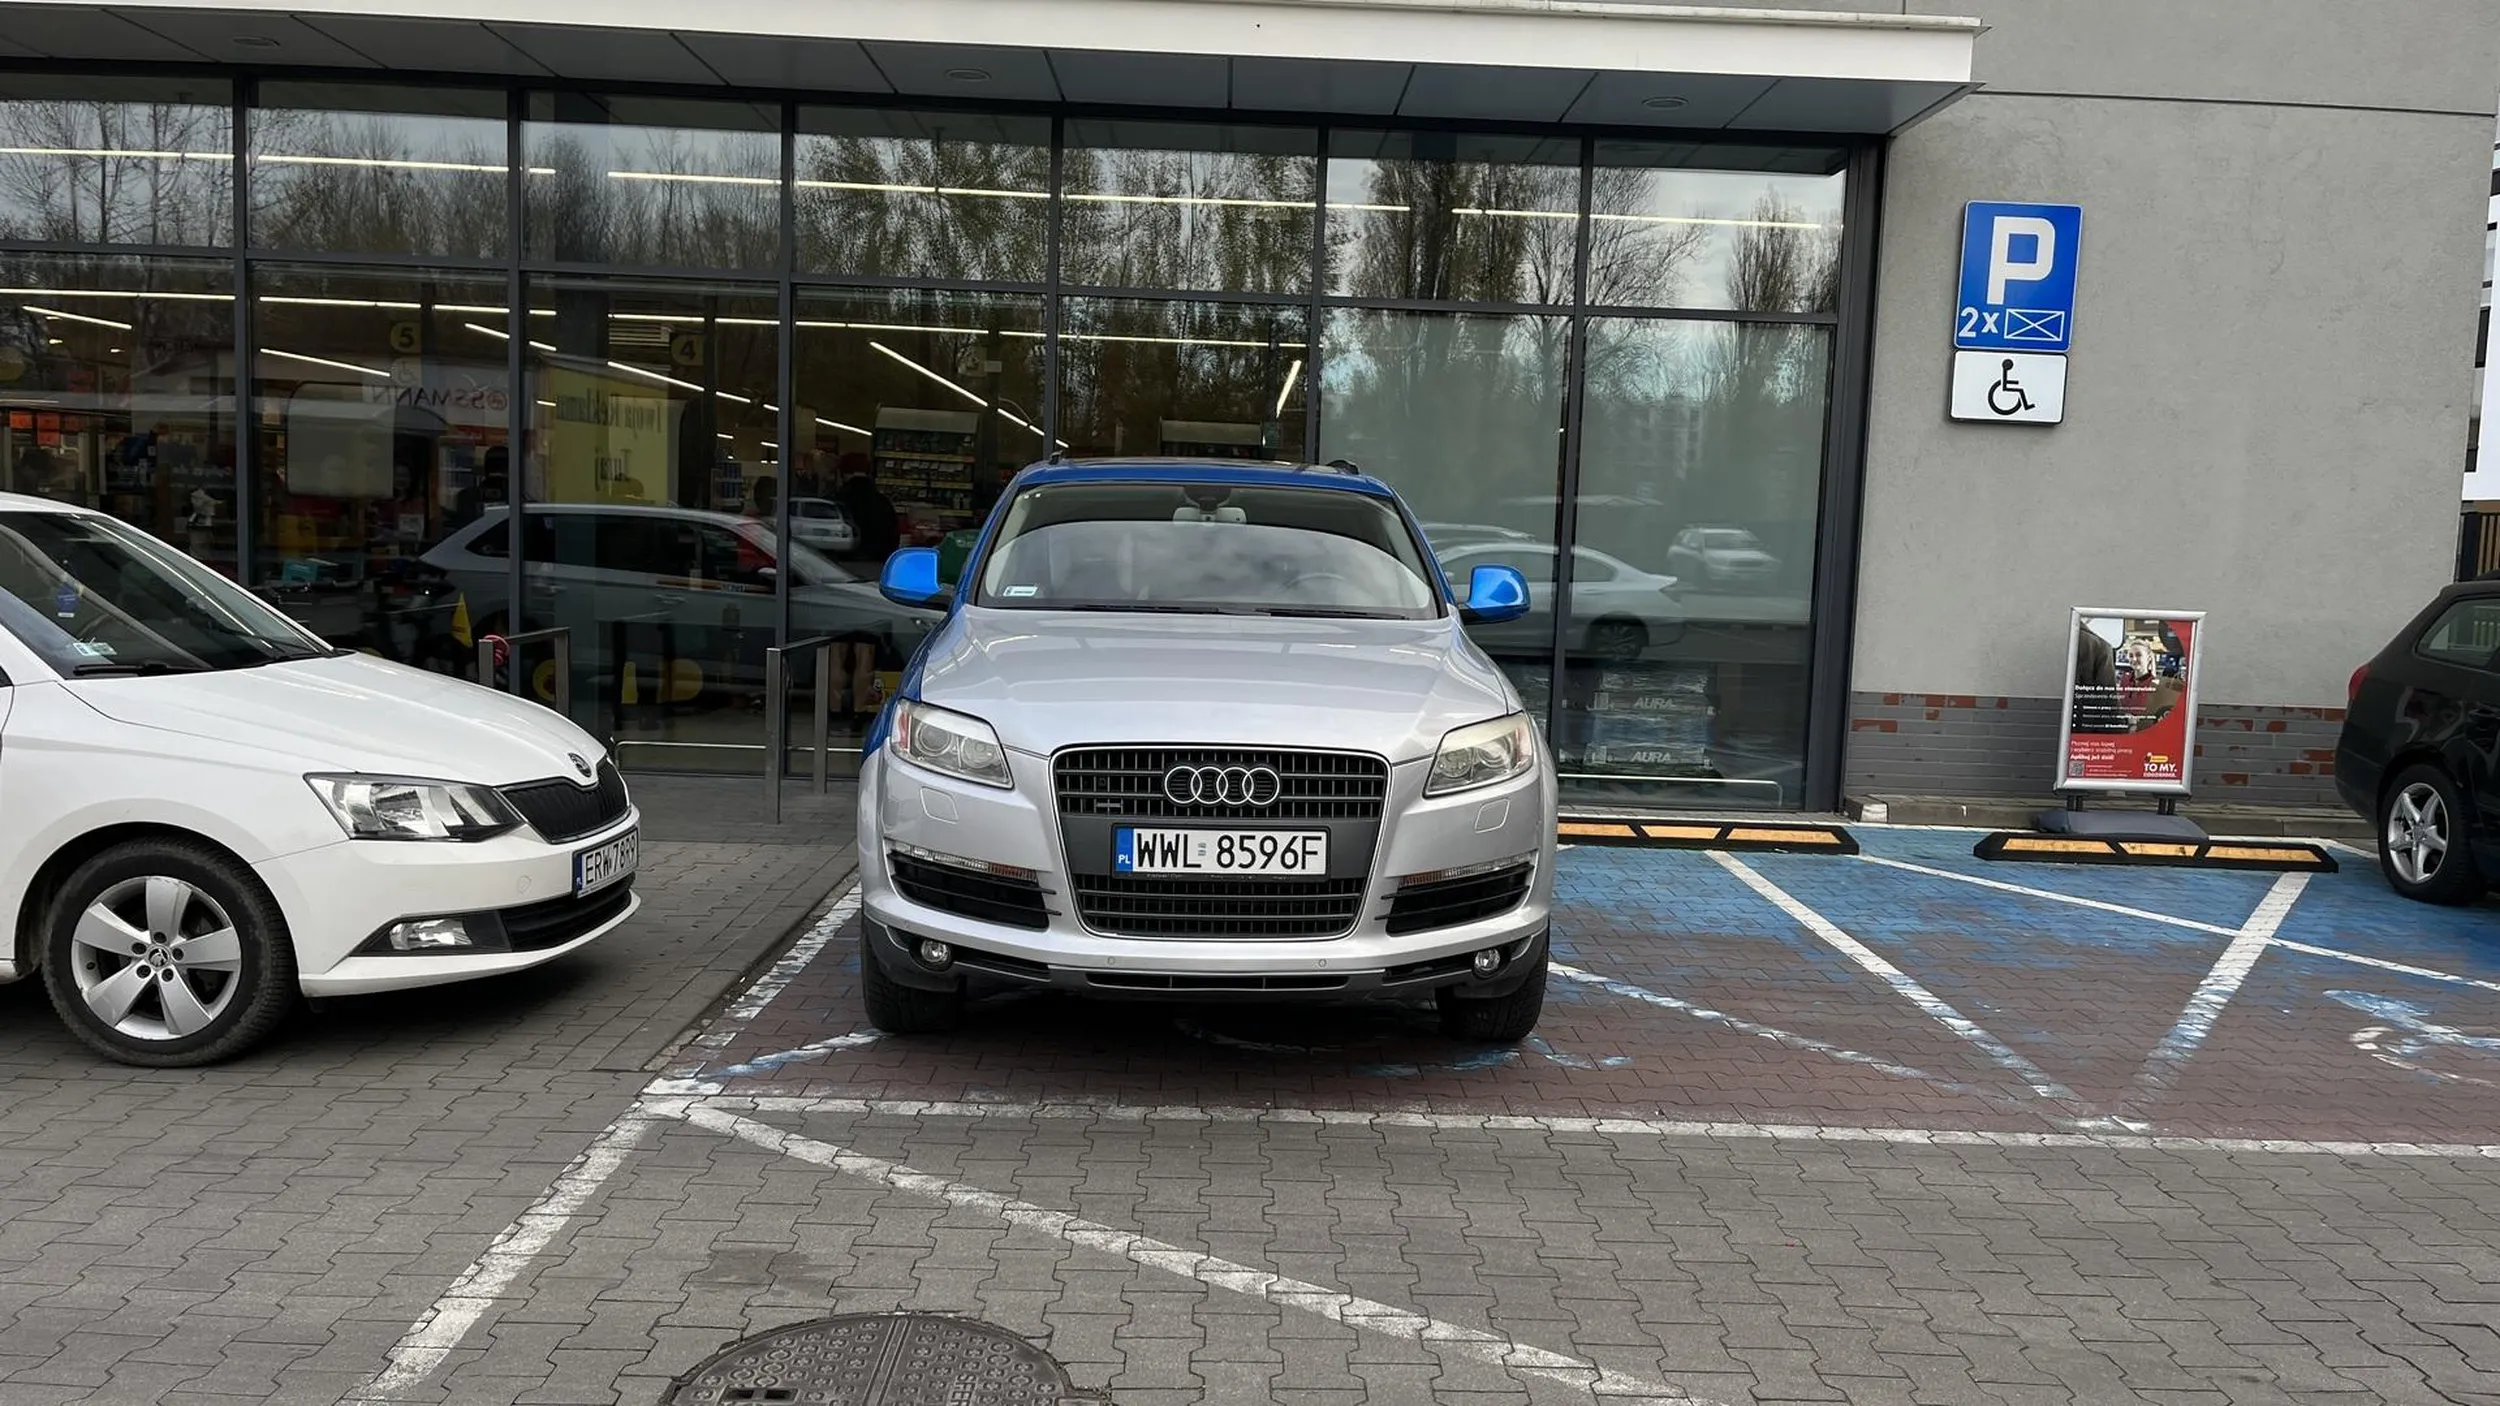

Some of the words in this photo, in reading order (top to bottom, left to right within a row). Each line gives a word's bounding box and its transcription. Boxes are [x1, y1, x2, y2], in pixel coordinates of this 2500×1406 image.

[1987, 216, 2055, 305] P
[399, 327, 414, 348] 5
[680, 340, 696, 360] 4
[1633, 697, 1675, 709] AURA
[1631, 751, 1672, 762] AURA
[2144, 763, 2158, 772] TO
[2159, 763, 2178, 773] MY.
[1118, 854, 1131, 865] PL
[1137, 833, 1202, 868] WWL
[1216, 834, 1322, 870] 8596F
